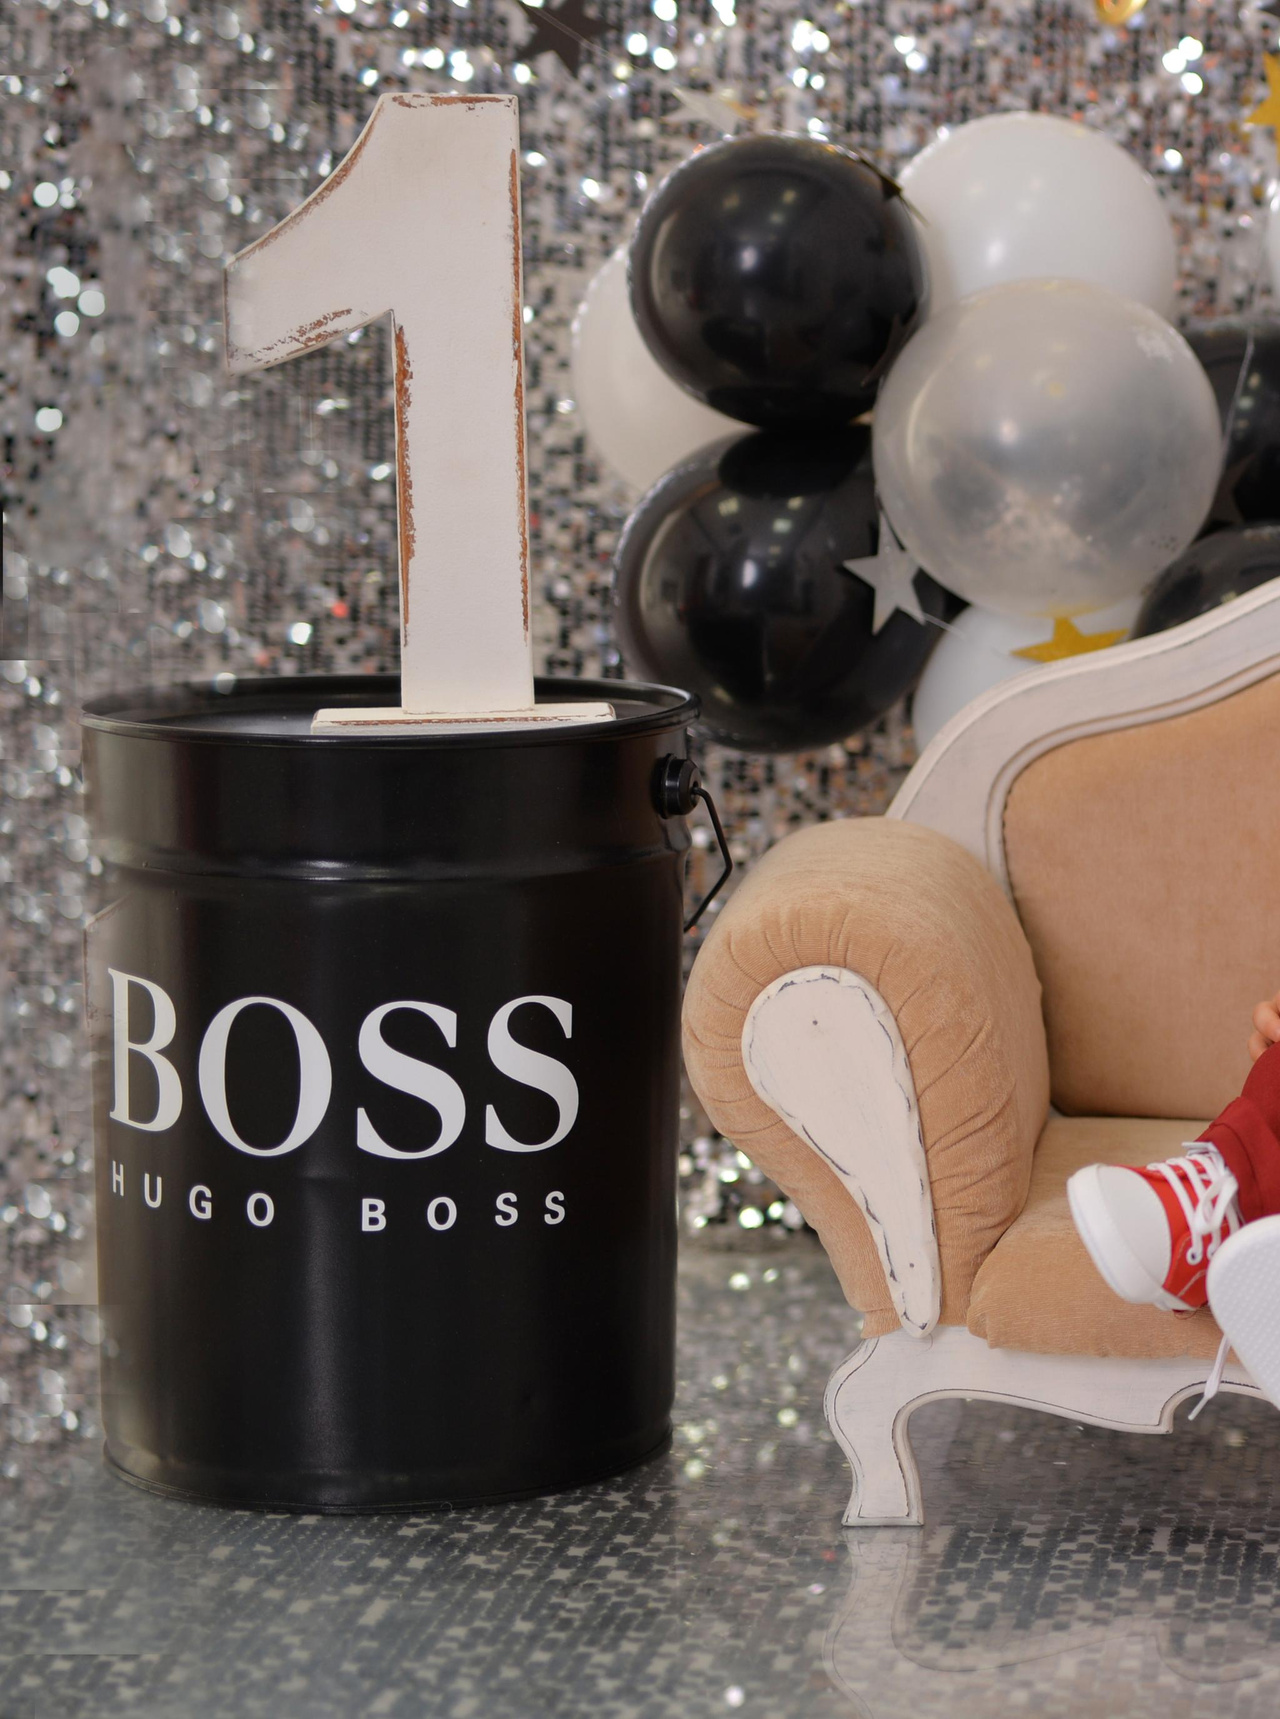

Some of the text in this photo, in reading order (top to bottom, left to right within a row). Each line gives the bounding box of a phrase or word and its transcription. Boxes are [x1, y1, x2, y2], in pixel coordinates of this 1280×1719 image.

[224, 92, 536, 714] 1
[107, 966, 580, 1160] BOSS
[111, 1160, 567, 1232] HUGO BOSS
